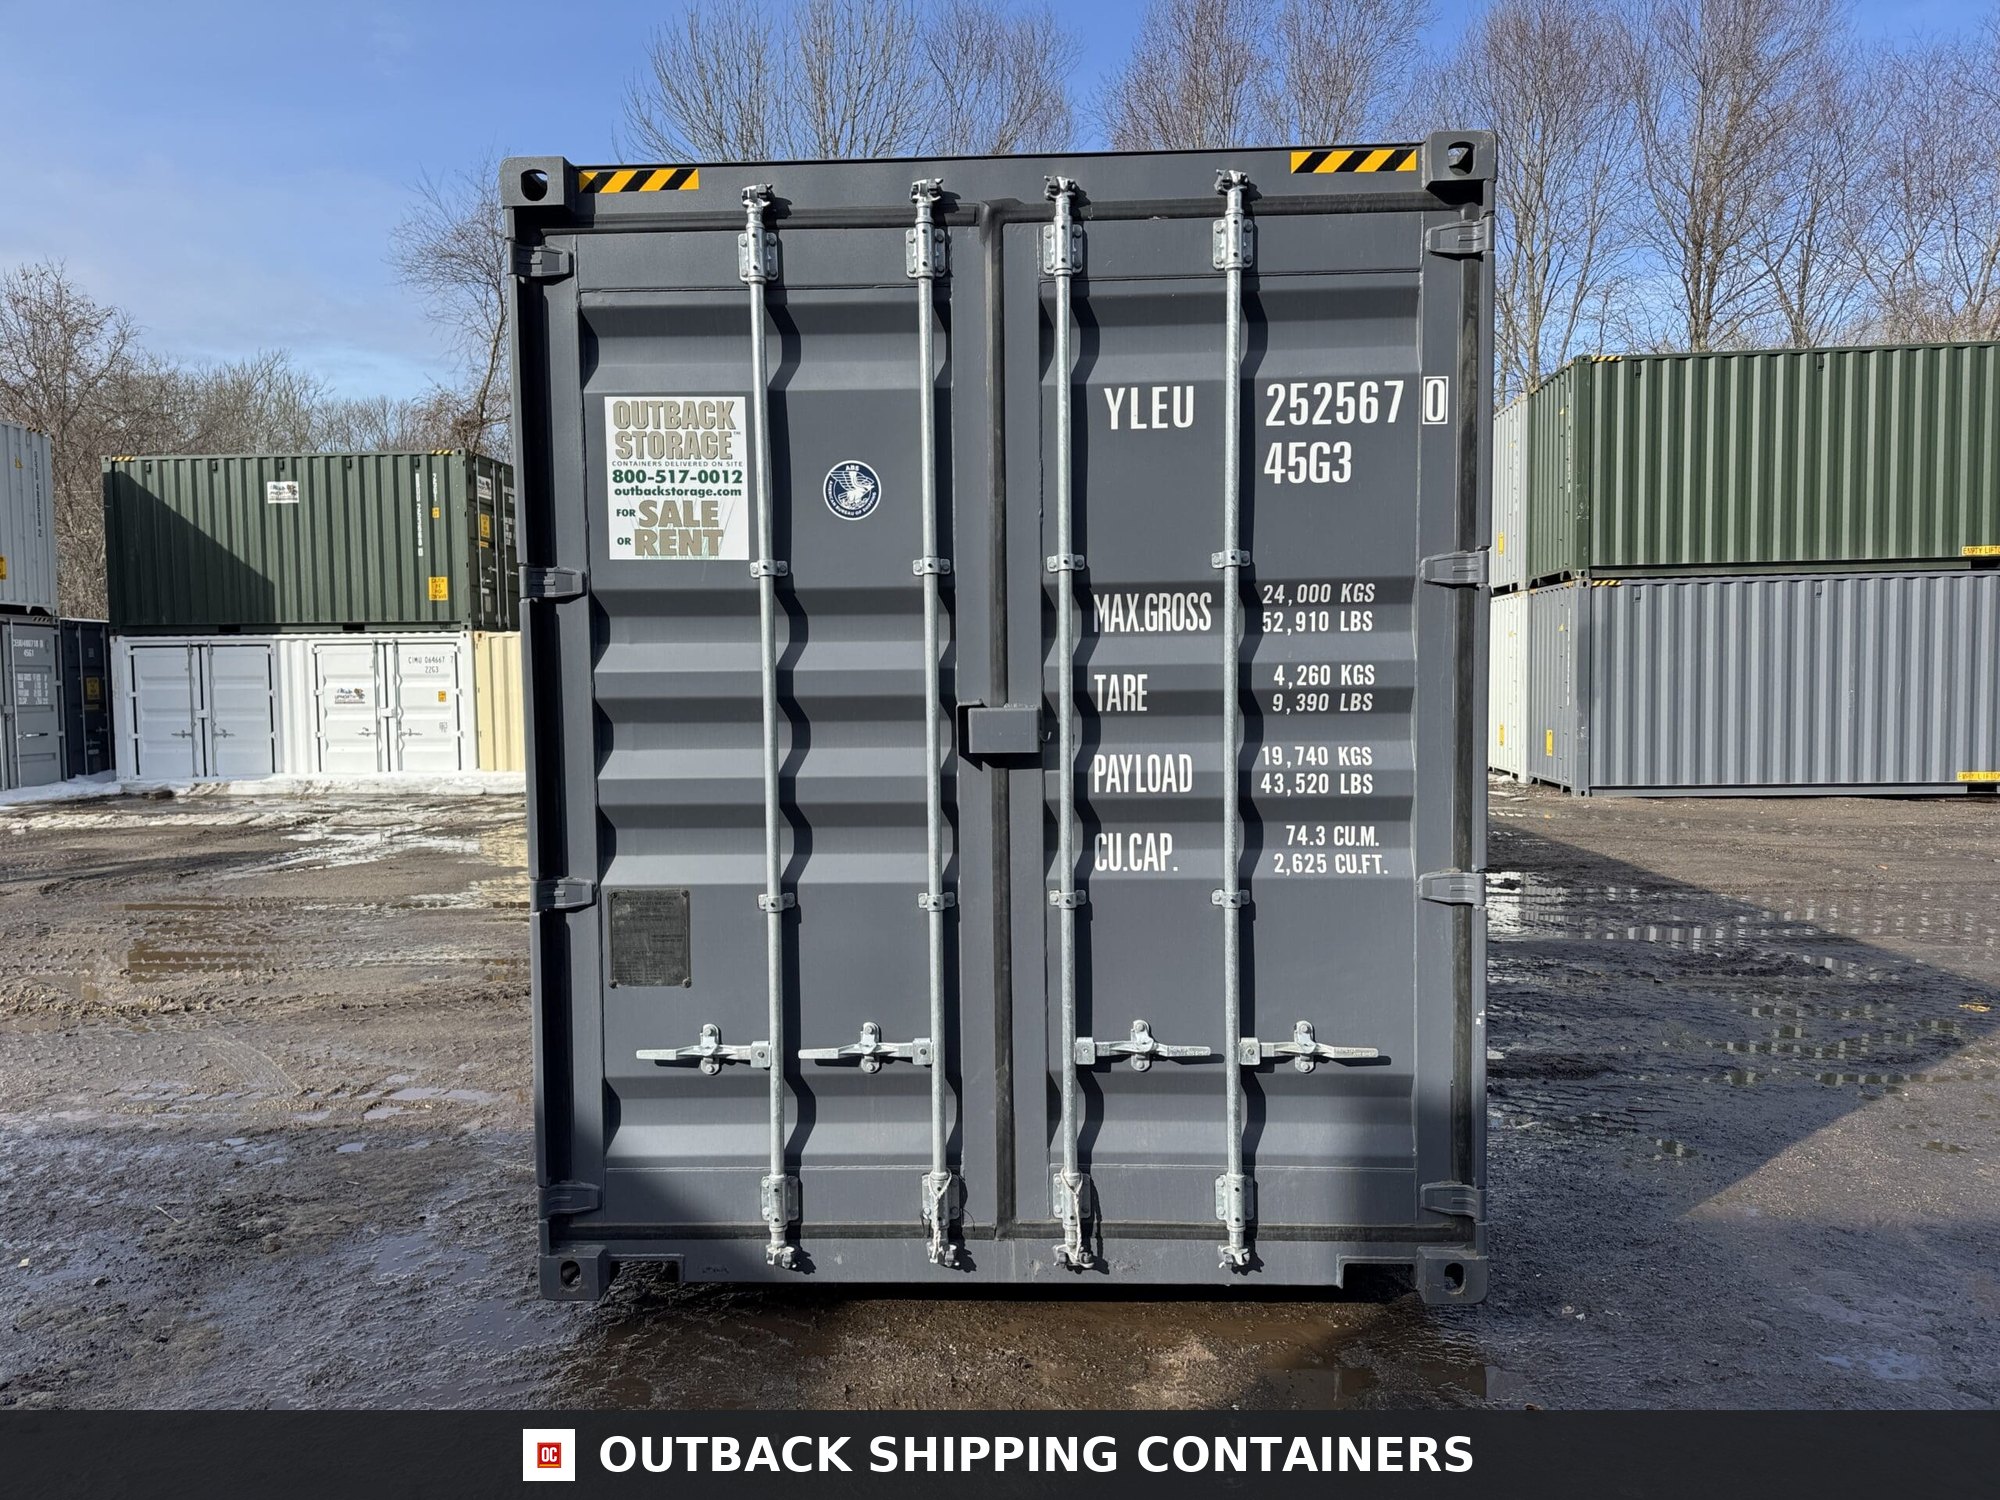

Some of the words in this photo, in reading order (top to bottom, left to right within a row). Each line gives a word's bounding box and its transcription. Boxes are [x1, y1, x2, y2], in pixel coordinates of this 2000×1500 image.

[613, 400, 736, 430] OUTBACK
[1104, 386, 1194, 429] YLEU
[1266, 380, 1404, 426] 252567
[1423, 376, 1447, 424] 0
[614, 431, 733, 460] STORAGE
[1264, 442, 1351, 484] 45G3
[612, 469, 743, 484] 800-517-0012
[614, 486, 742, 498] outbackstorage.com
[616, 508, 636, 517] FOR
[638, 500, 719, 528] SALE
[617, 537, 631, 545] OR
[634, 529, 724, 556] RENT
[1262, 584, 1331, 606] 24,000
[1341, 584, 1375, 602] KGS
[1094, 593, 1212, 632] MAX.GROSS
[1262, 610, 1329, 636] 52,910
[1340, 610, 1373, 631] LBS
[1274, 665, 1331, 689] 4,260
[1341, 664, 1375, 685] KGS
[1094, 674, 1148, 711] TARE
[1273, 693, 1328, 714] 9,390
[1340, 693, 1373, 711] LBS
[1262, 746, 1329, 768] 19,740
[1338, 746, 1372, 766] KGS
[1094, 754, 1193, 793] PAYLOAD
[1261, 773, 1329, 796] 43,520
[1340, 773, 1373, 794] LBS
[1286, 825, 1326, 846] 74.3
[1334, 826, 1379, 846] CU.M.
[1094, 833, 1178, 872] CU.CAP.
[1273, 853, 1328, 875] 2,625
[1335, 853, 1388, 874] CU.FT.
